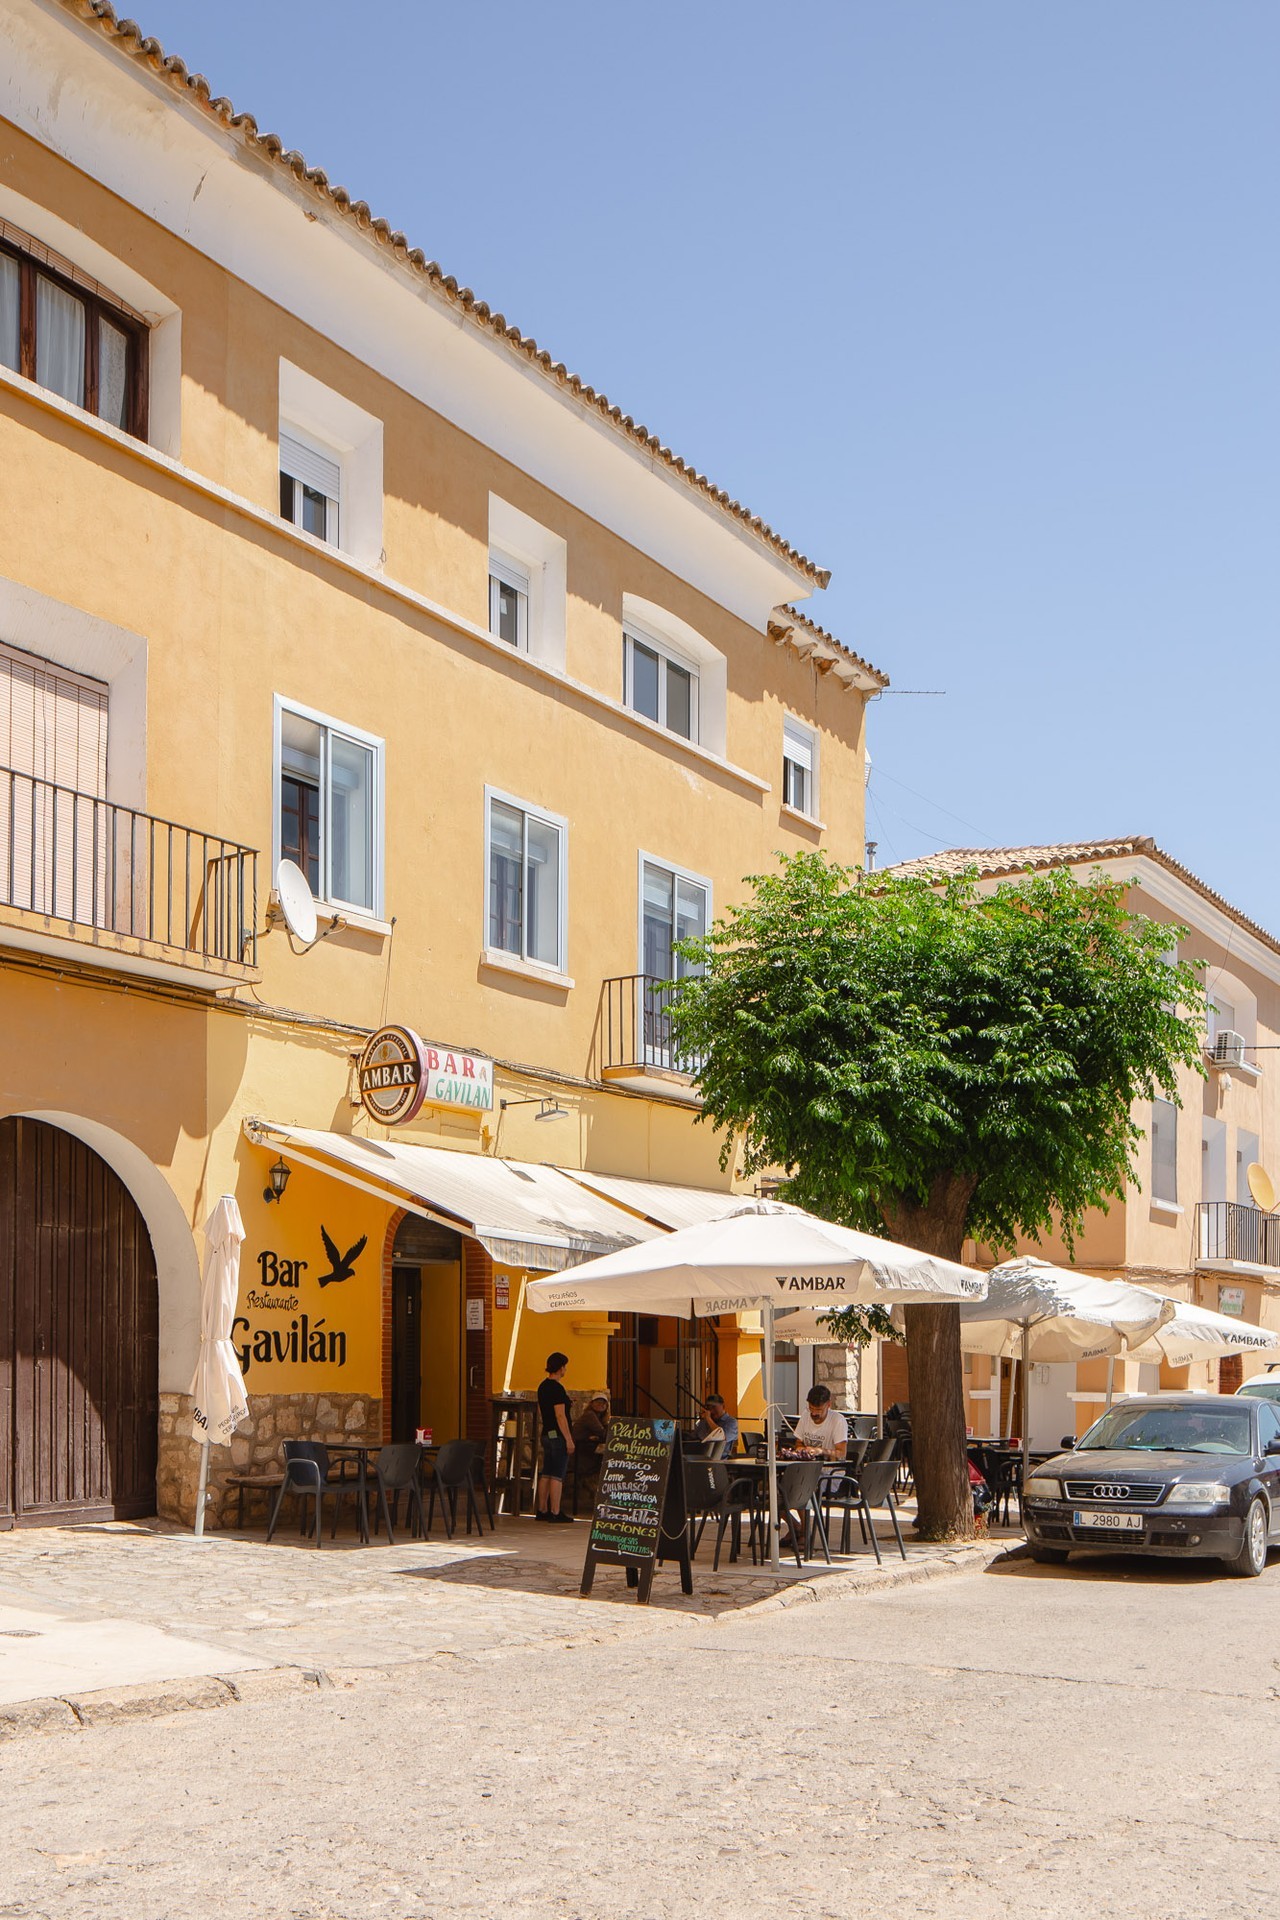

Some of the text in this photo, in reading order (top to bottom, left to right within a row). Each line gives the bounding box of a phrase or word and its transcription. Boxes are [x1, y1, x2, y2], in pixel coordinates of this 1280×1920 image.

[426, 1048, 476, 1078] BAR
[363, 1064, 416, 1091] AMBAR
[435, 1078, 491, 1108] GAVILAN
[257, 1250, 308, 1288] Bar
[788, 1276, 846, 1291] AMBAR
[247, 1290, 299, 1312] Restaurante
[230, 1314, 346, 1376] Gavilán
[1230, 1334, 1267, 1347] AMBAR
[611, 1422, 651, 1440] Platos
[608, 1437, 670, 1457] Combinados
[606, 1458, 651, 1471] Ternasco
[603, 1469, 660, 1485] Lomo Sepia
[601, 1482, 648, 1494] CHURRASCO
[597, 1508, 660, 1526] Bocadillos
[1080, 1513, 1141, 1528] L 2980 AJ
